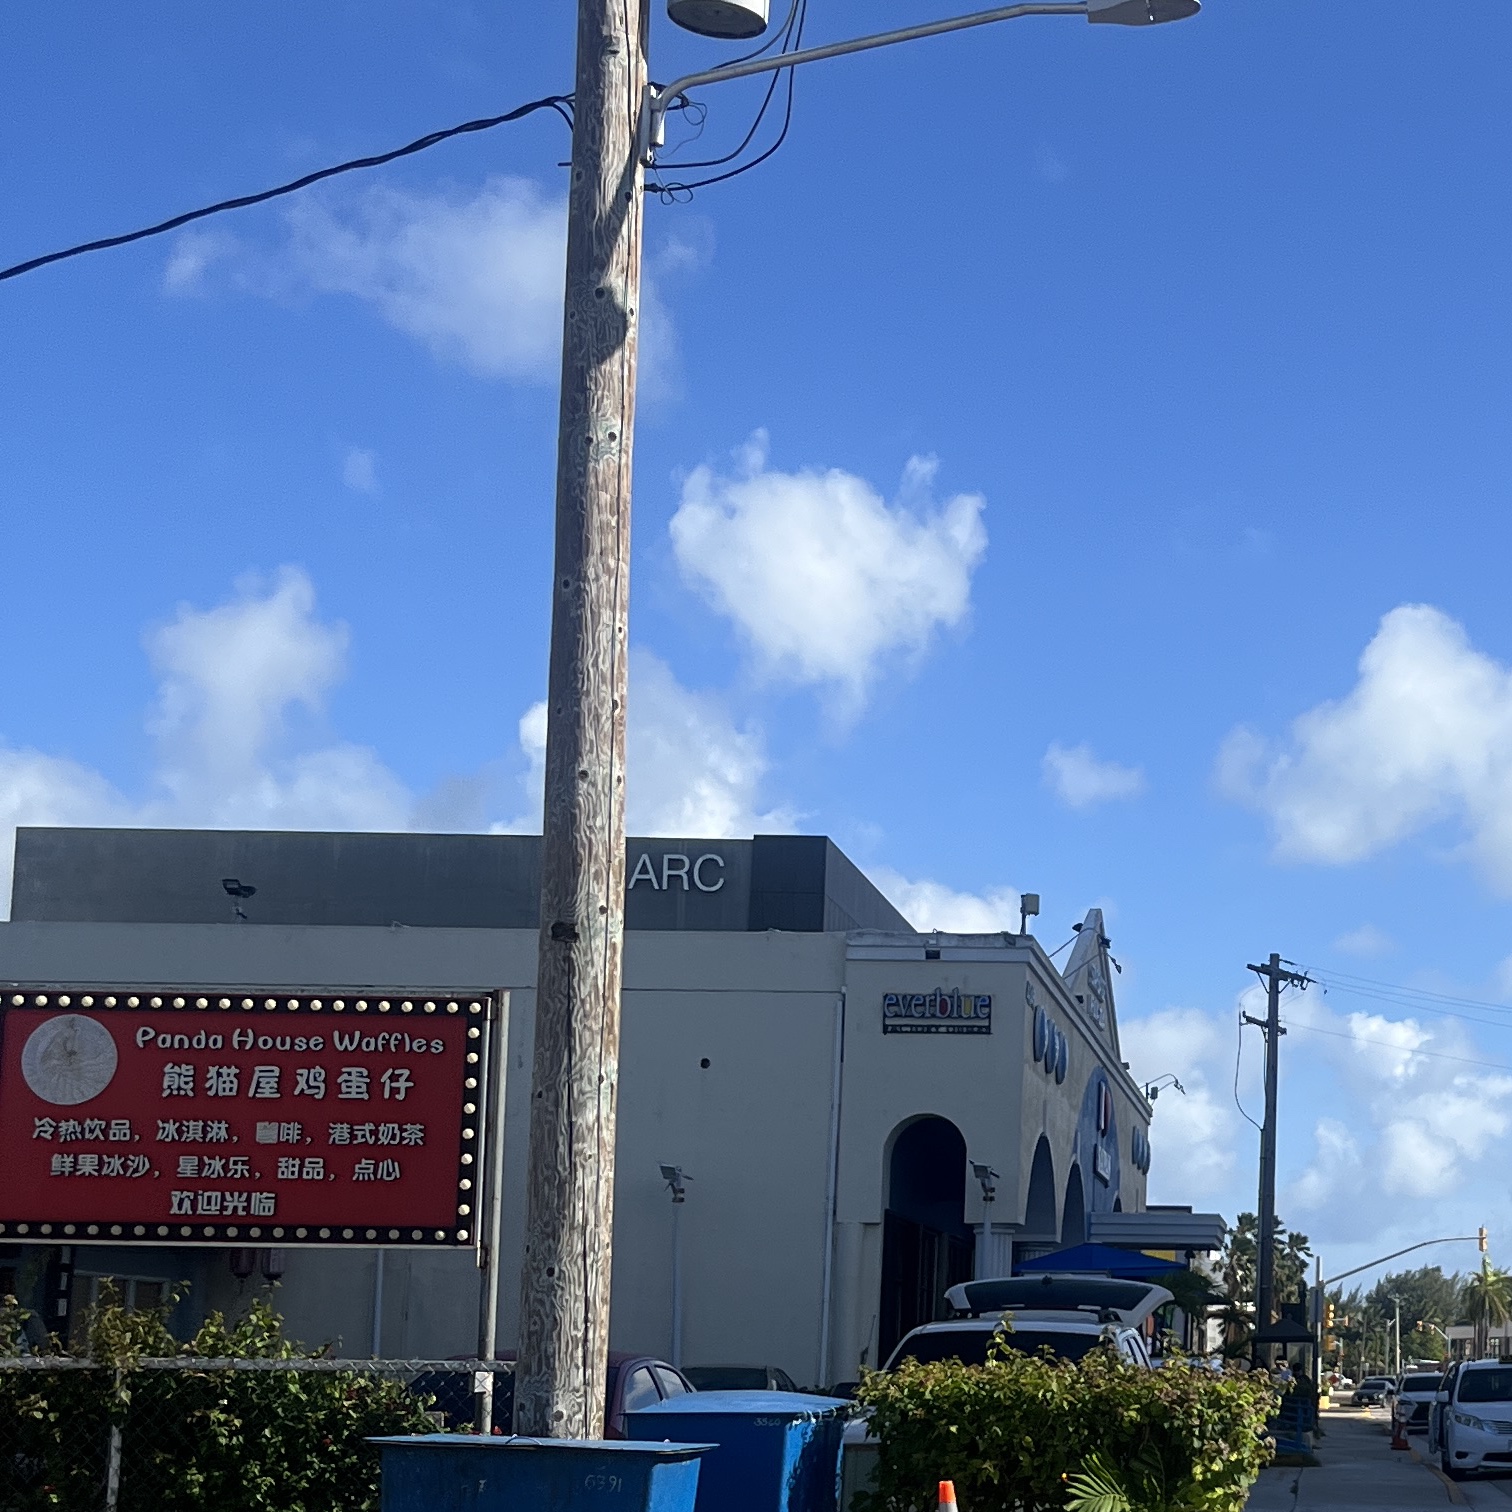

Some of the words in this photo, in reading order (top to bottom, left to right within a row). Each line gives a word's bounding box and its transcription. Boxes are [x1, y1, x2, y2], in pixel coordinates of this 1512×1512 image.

[628, 853, 725, 892] ARC
[884, 987, 990, 1019] everblue
[136, 1026, 223, 1049] Panda
[232, 1028, 324, 1051] House
[333, 1030, 445, 1054] Waffles
[161, 1062, 415, 1101] 熊猫屋鸡蛋仔
[32, 1116, 425, 1148] 冷热饮品，冰淇淋，啡，港式奶茶
[169, 1189, 277, 1217] 欢迎光临
